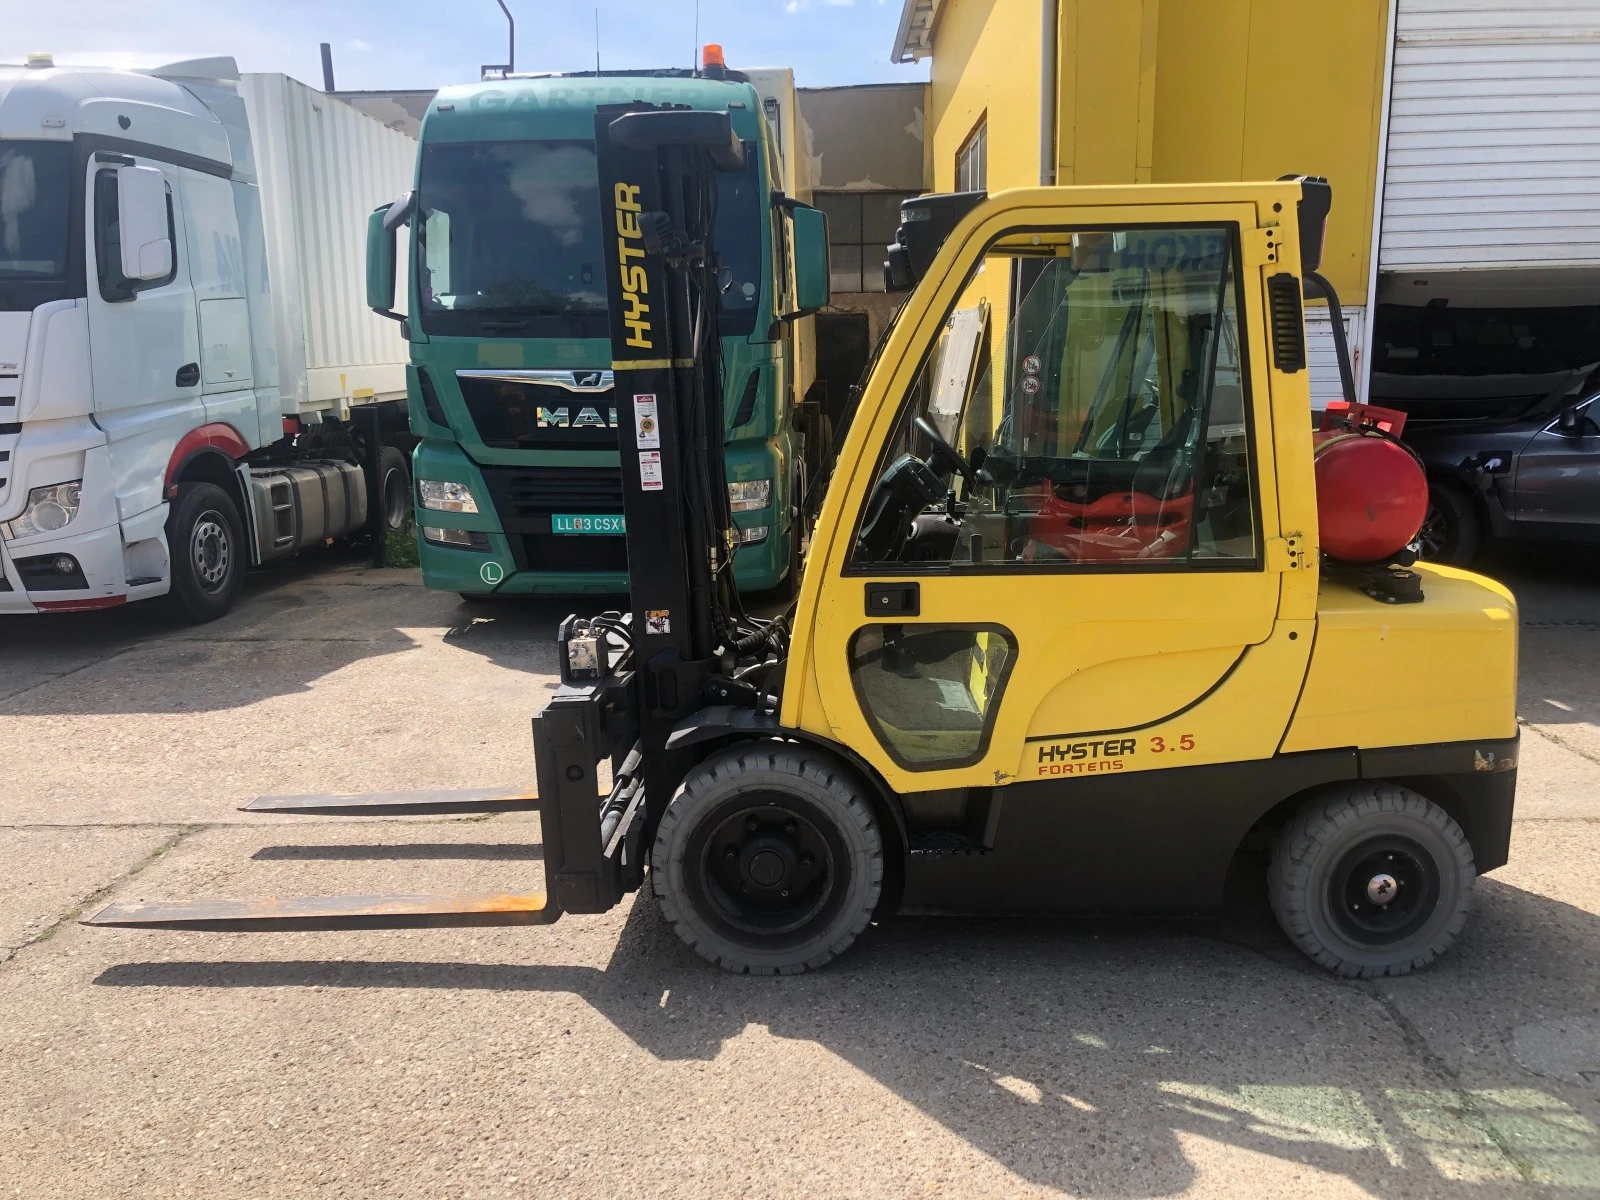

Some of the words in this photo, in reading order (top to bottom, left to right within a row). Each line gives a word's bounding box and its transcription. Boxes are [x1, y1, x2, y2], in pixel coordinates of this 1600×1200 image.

[614, 182, 653, 349] HYSTER
[557, 518, 573, 530] LL
[594, 518, 619, 530] CSX
[1038, 738, 1137, 763] HYSTER
[1150, 733, 1196, 754] 3.5
[1038, 760, 1124, 776] FORTENS
